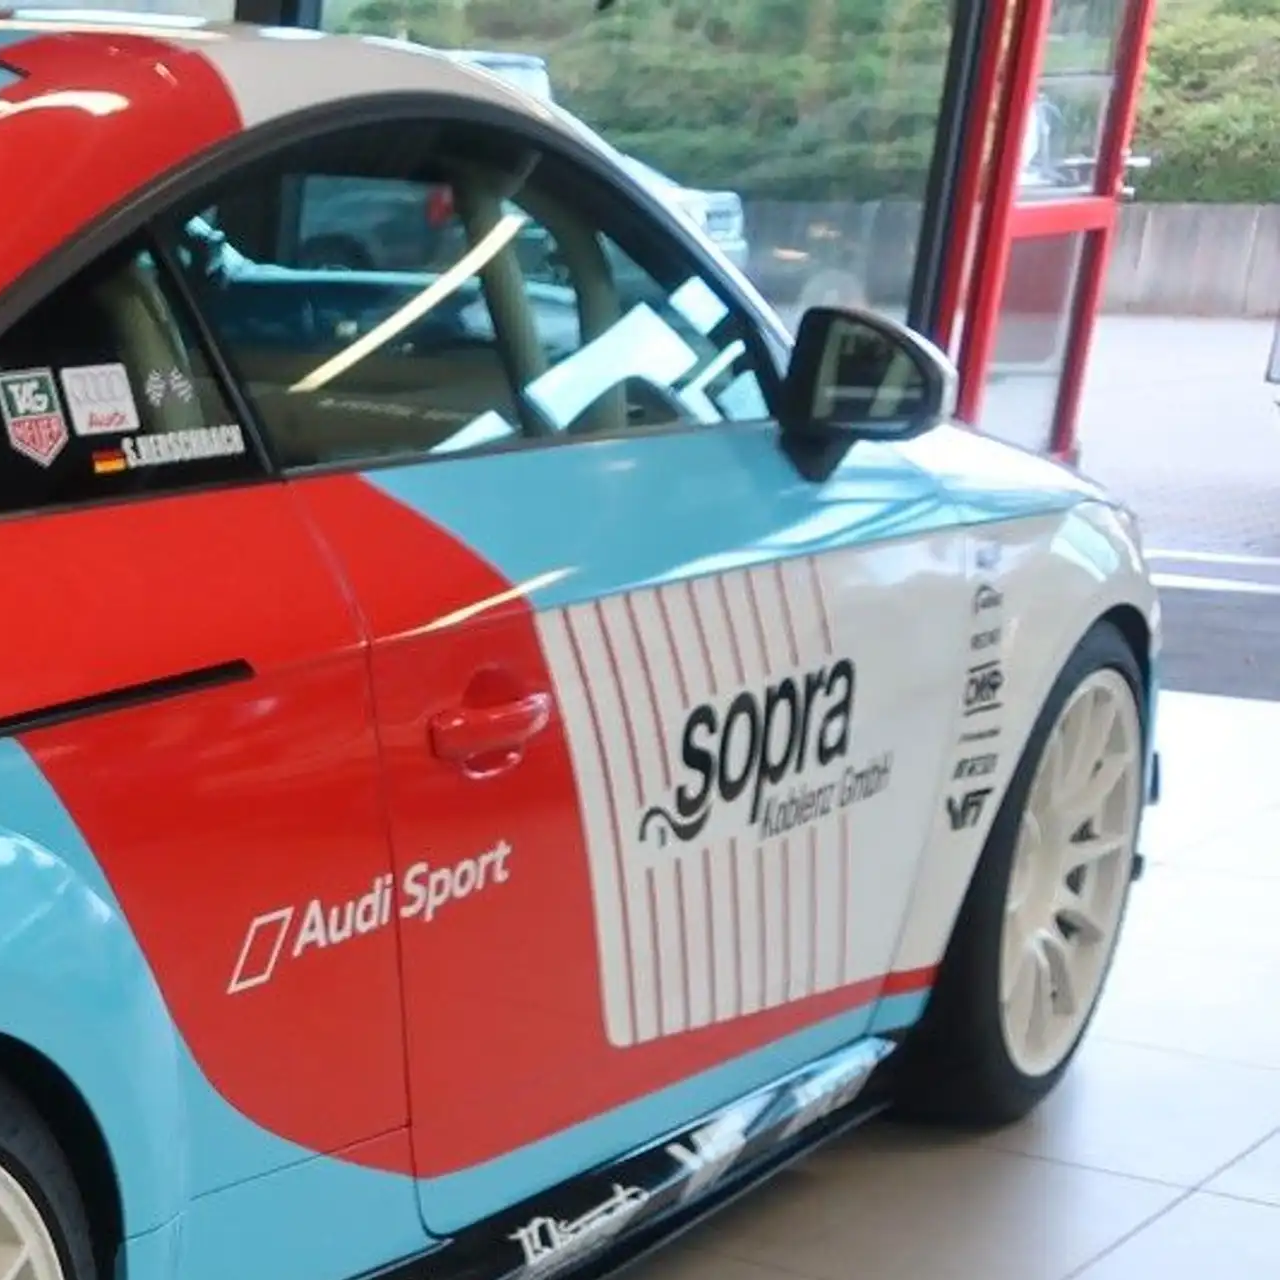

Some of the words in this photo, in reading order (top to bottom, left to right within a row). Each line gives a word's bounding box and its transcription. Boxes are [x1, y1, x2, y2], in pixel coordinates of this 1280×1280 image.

[676, 658, 855, 824] sopra
[760, 781, 836, 839] Koblenz
[292, 872, 394, 958] Audi
[400, 839, 513, 923] Sport
